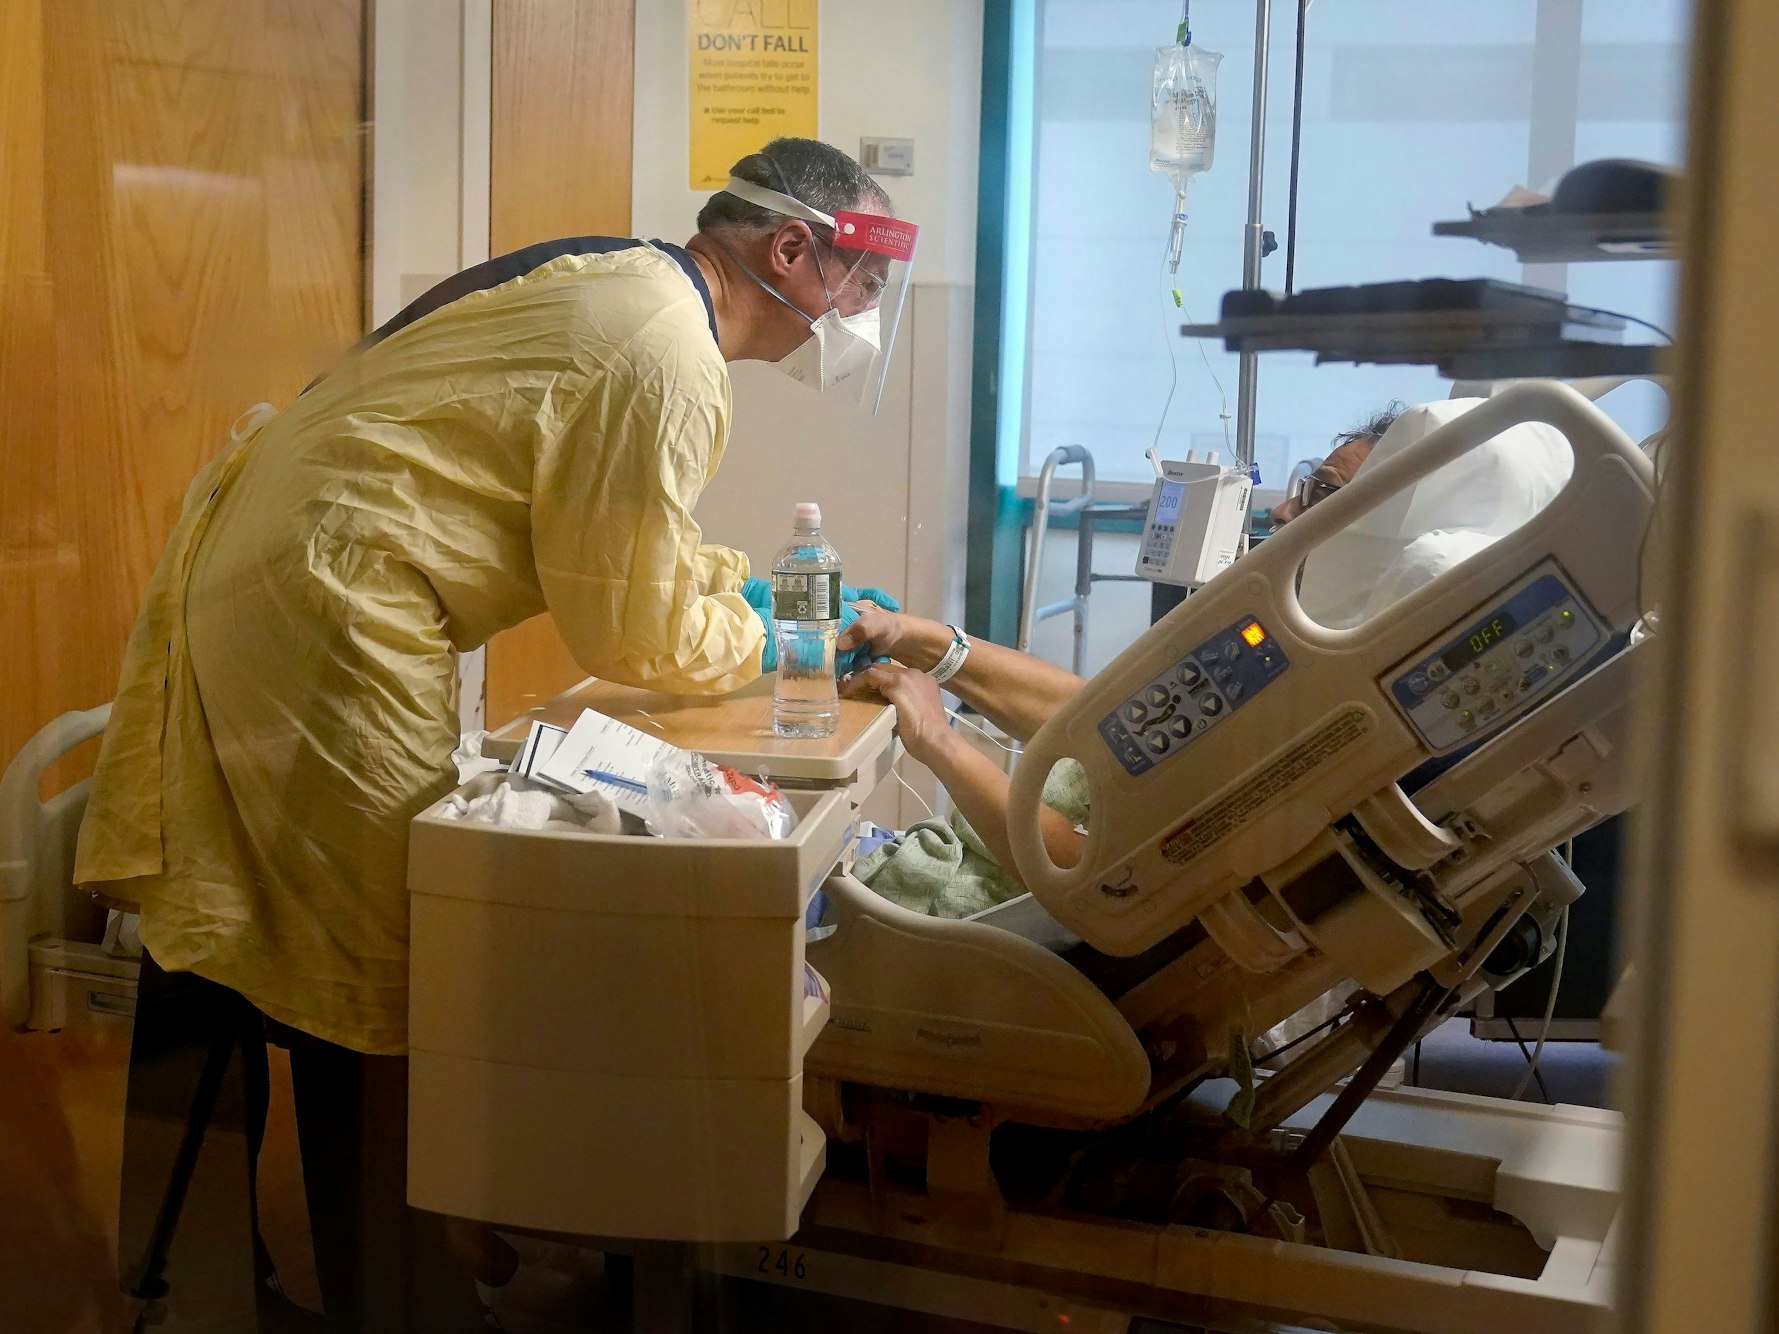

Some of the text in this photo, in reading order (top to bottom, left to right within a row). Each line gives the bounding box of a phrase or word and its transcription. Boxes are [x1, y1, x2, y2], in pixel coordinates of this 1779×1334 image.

[698, 34, 809, 52] DON'T FALL
[869, 226, 912, 243] ARLINGTON
[1160, 495, 1178, 509] 200
[1469, 618, 1504, 652] OFF
[758, 1246, 806, 1279] 246
